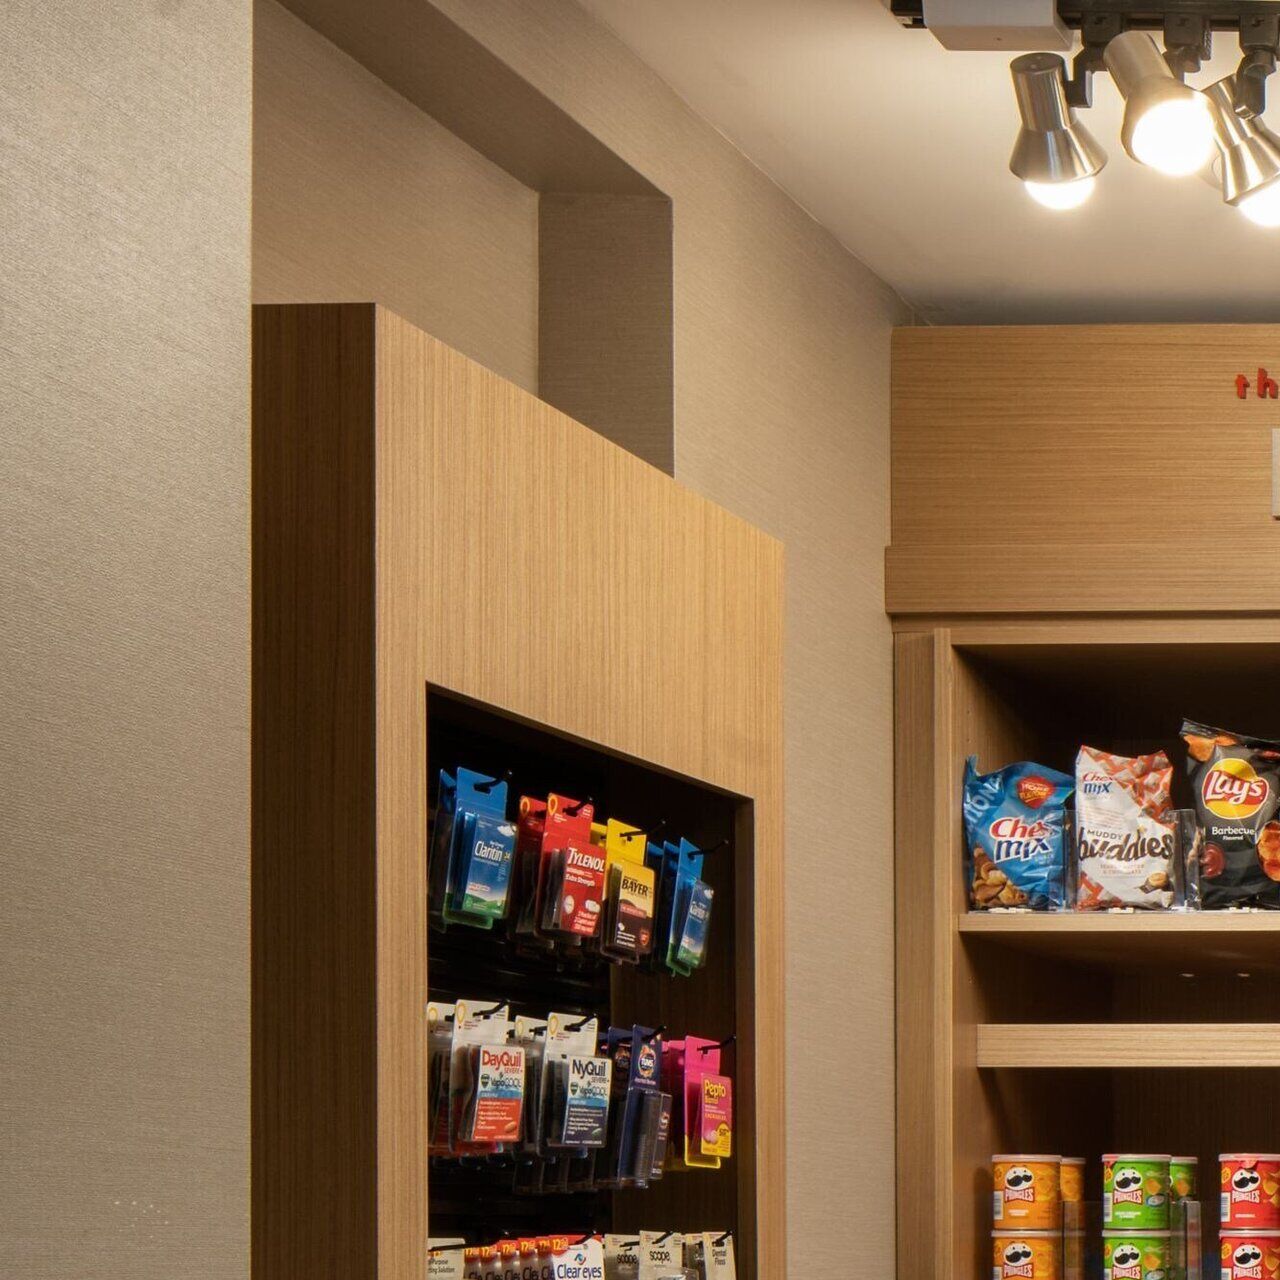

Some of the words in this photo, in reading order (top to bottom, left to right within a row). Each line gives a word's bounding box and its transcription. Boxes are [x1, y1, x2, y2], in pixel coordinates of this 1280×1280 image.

[1083, 781, 1112, 795] mix
[1204, 769, 1264, 805] Lay's
[1086, 829, 1124, 842] MUDDY
[1211, 825, 1257, 837] Barbecue
[993, 837, 1051, 864] mix
[1078, 825, 1174, 862] buddies
[474, 841, 503, 862] Claritin
[567, 847, 605, 872] TYLENOL
[621, 878, 649, 897] BAYER
[481, 1050, 522, 1071] DayQuil
[572, 1059, 607, 1080] NyQuil
[704, 1078, 727, 1098] Pepto
[1004, 1188, 1034, 1203] PRINGLES
[1112, 1191, 1142, 1205] PRINGLES
[1231, 1190, 1261, 1204] PRINGLES
[650, 1250, 671, 1265] scope
[712, 1248, 727, 1257] Dental
[556, 1264, 581, 1280] Clear
[1003, 1265, 1033, 1279] PRINGLES
[1112, 1265, 1142, 1280] PRINGLES
[1231, 1265, 1262, 1279] PRINGLES
